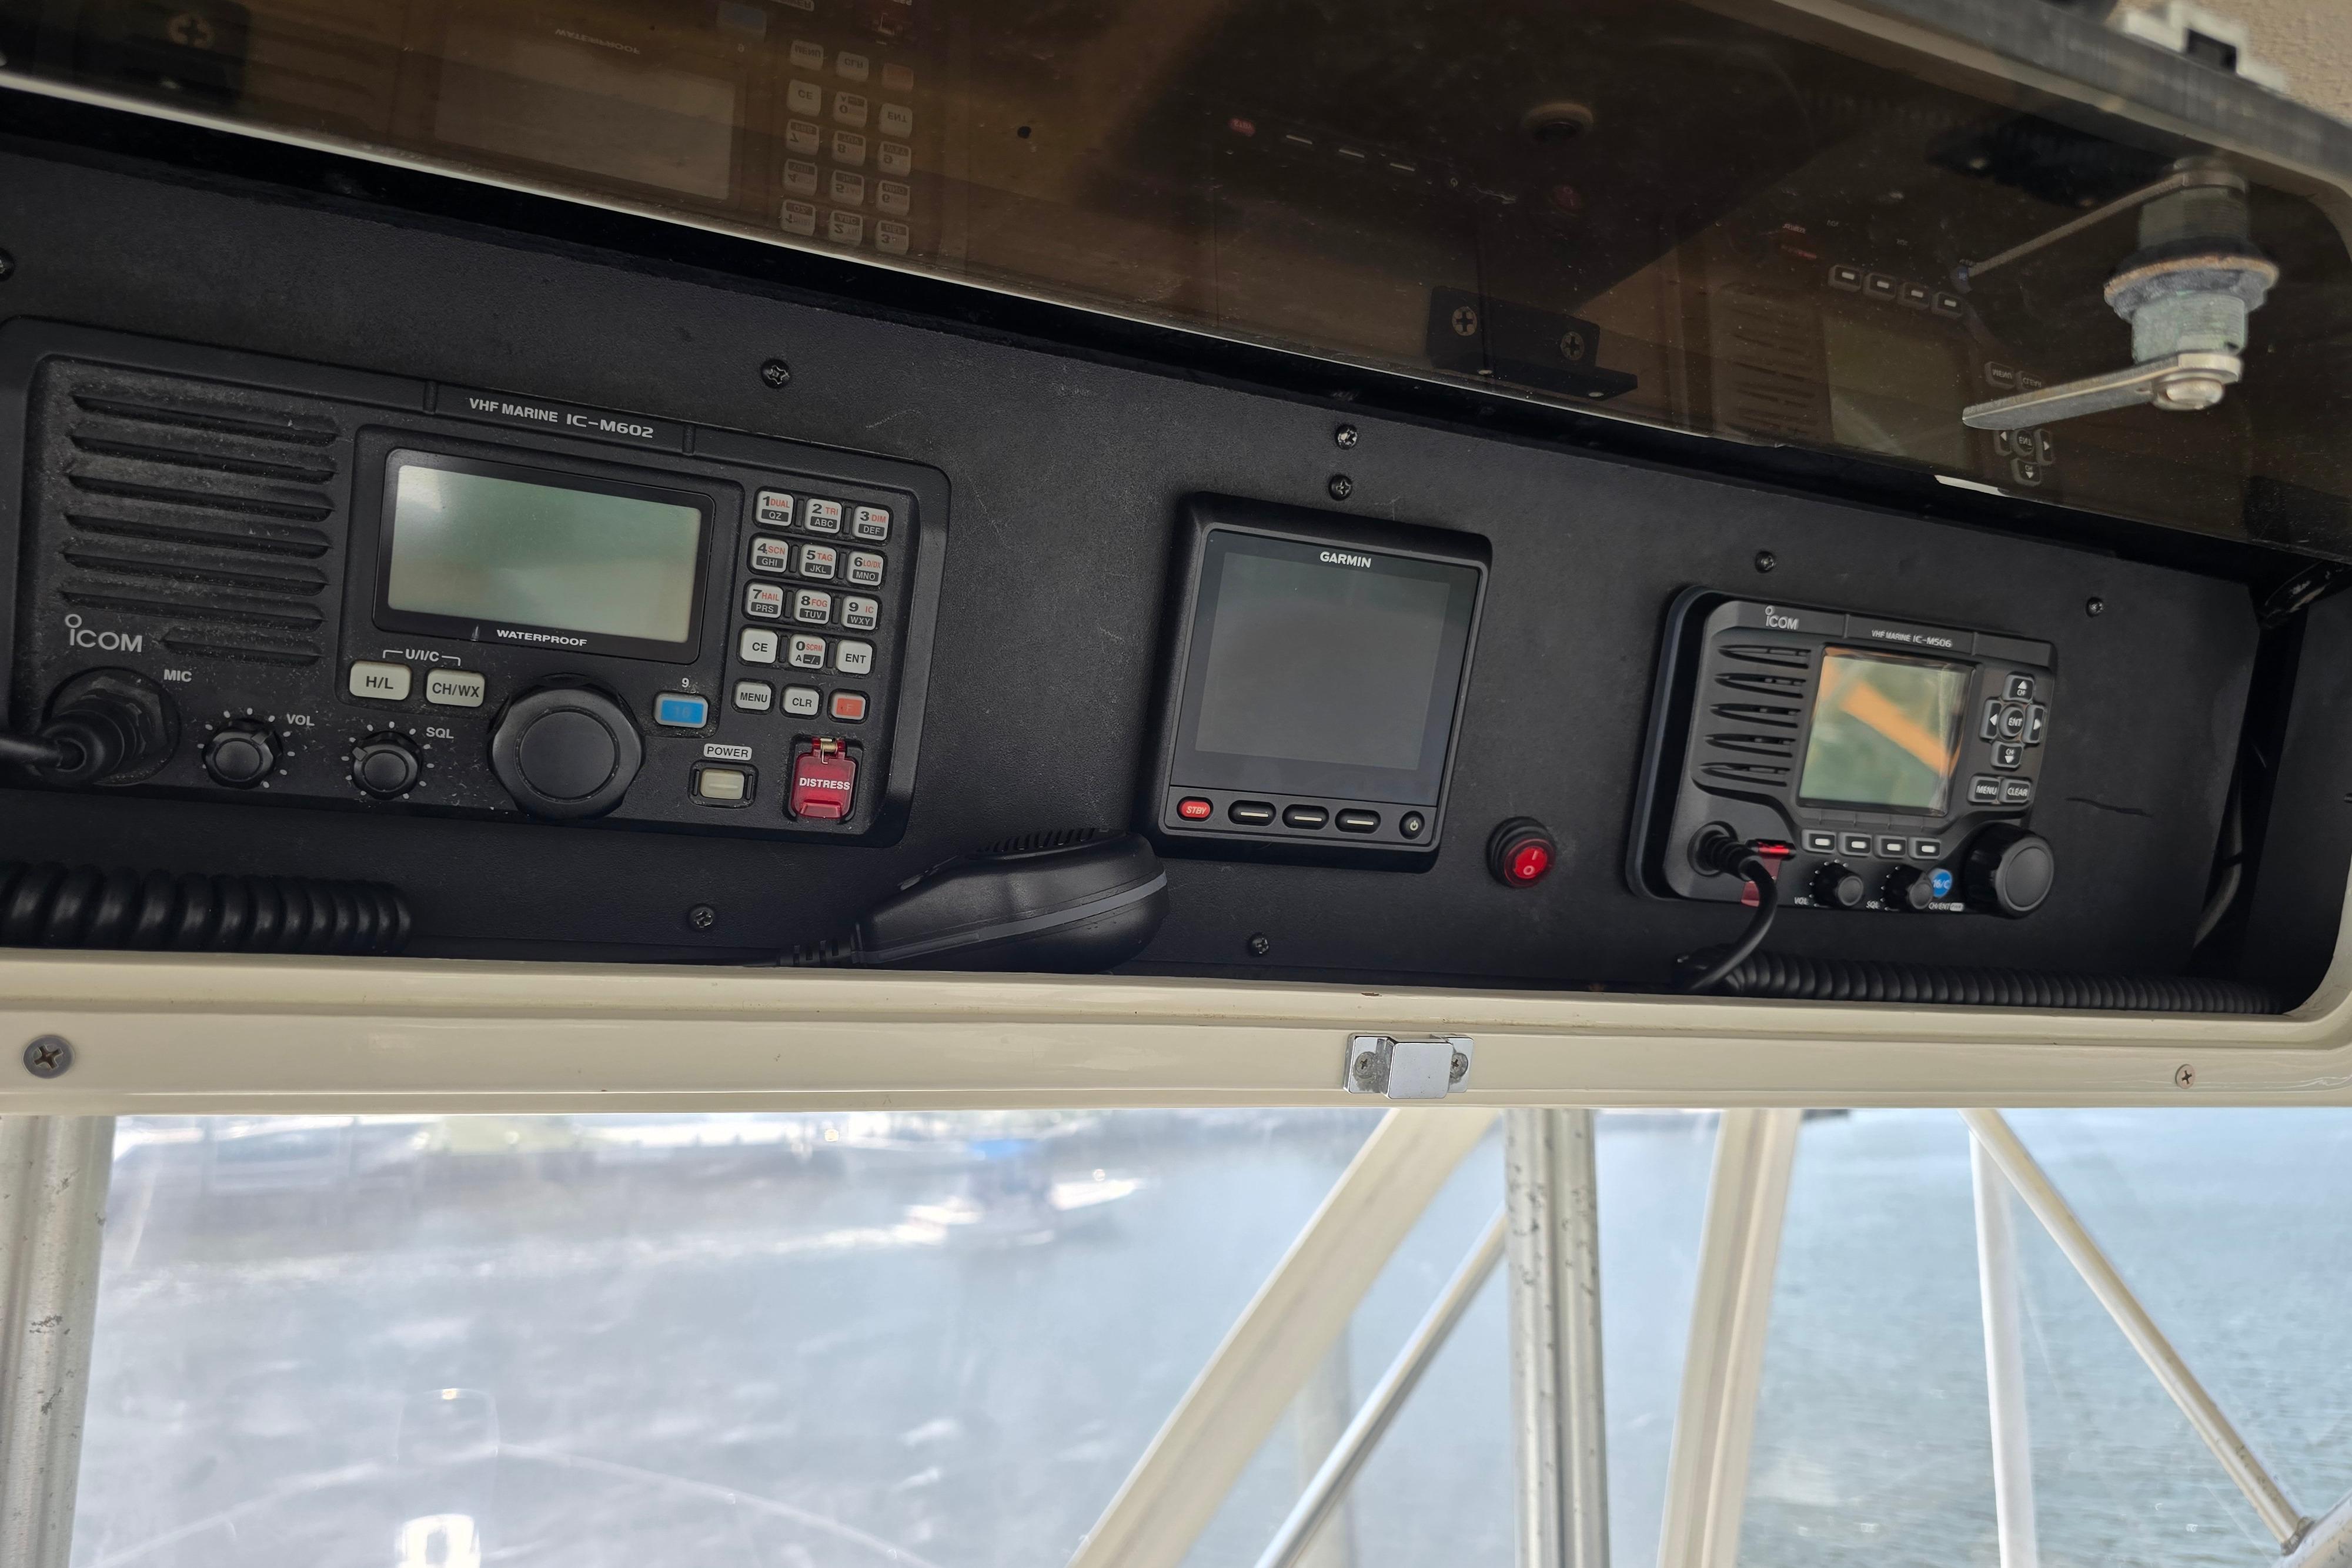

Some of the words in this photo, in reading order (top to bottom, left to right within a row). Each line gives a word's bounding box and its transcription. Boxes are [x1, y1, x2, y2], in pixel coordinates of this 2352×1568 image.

[469, 397, 499, 412] VHF
[502, 404, 558, 422] MARINE
[566, 413, 654, 439] IC-M602
[763, 496, 770, 506] 1
[770, 498, 790, 509] DUAL
[812, 503, 823, 514] 2
[825, 507, 838, 516] TRI
[769, 511, 781, 520] QZ
[860, 511, 870, 521] 3
[871, 514, 887, 523] DIM
[814, 519, 834, 527] ABC
[863, 526, 881, 535] DEF
[757, 543, 767, 553] 4
[768, 546, 785, 555] SCN
[806, 550, 816, 560] 5
[817, 553, 833, 561] TAG
[1320, 551, 1371, 568] GARMIN
[762, 558, 778, 566] GHI
[854, 557, 863, 567] 6
[863, 560, 882, 569] LO/DX
[810, 564, 827, 573] JKL
[856, 571, 876, 580] MNO
[753, 589, 763, 599] 7
[761, 592, 779, 601] HAIL
[801, 596, 810, 606] 8
[811, 599, 827, 608] FOG
[756, 604, 774, 613] PRS
[848, 602, 859, 612] 9
[865, 606, 874, 614] IC
[805, 610, 823, 618] TUV
[850, 616, 871, 626] WXY
[496, 629, 587, 647] WATERPROOF
[1872, 630, 1885, 638] VHF
[1885, 632, 1912, 642] MARINE
[1912, 635, 1952, 648] IC-M506
[752, 642, 768, 652] CE
[796, 641, 806, 651] 0
[806, 644, 823, 652] SCRM
[405, 648, 440, 662] U/I/C
[846, 653, 867, 664] ENT
[163, 669, 192, 683] MIC
[366, 676, 394, 690] H/L
[682, 678, 689, 688] 9
[432, 682, 480, 698] CH/WX
[740, 692, 768, 703] MENU
[792, 698, 813, 707] CLR
[286, 714, 315, 727] VOL
[2008, 717, 2023, 727] ENT
[426, 727, 454, 739] SQL
[707, 746, 749, 757] POWER
[799, 777, 851, 791] DISTRESS
[1976, 785, 1997, 794] MENU
[2007, 787, 2028, 797] CLEAR
[1186, 806, 1207, 815] STBY
[1933, 879, 1950, 889] 16/C
[1794, 897, 1808, 905] VOL
[1866, 900, 1880, 909] SQL
